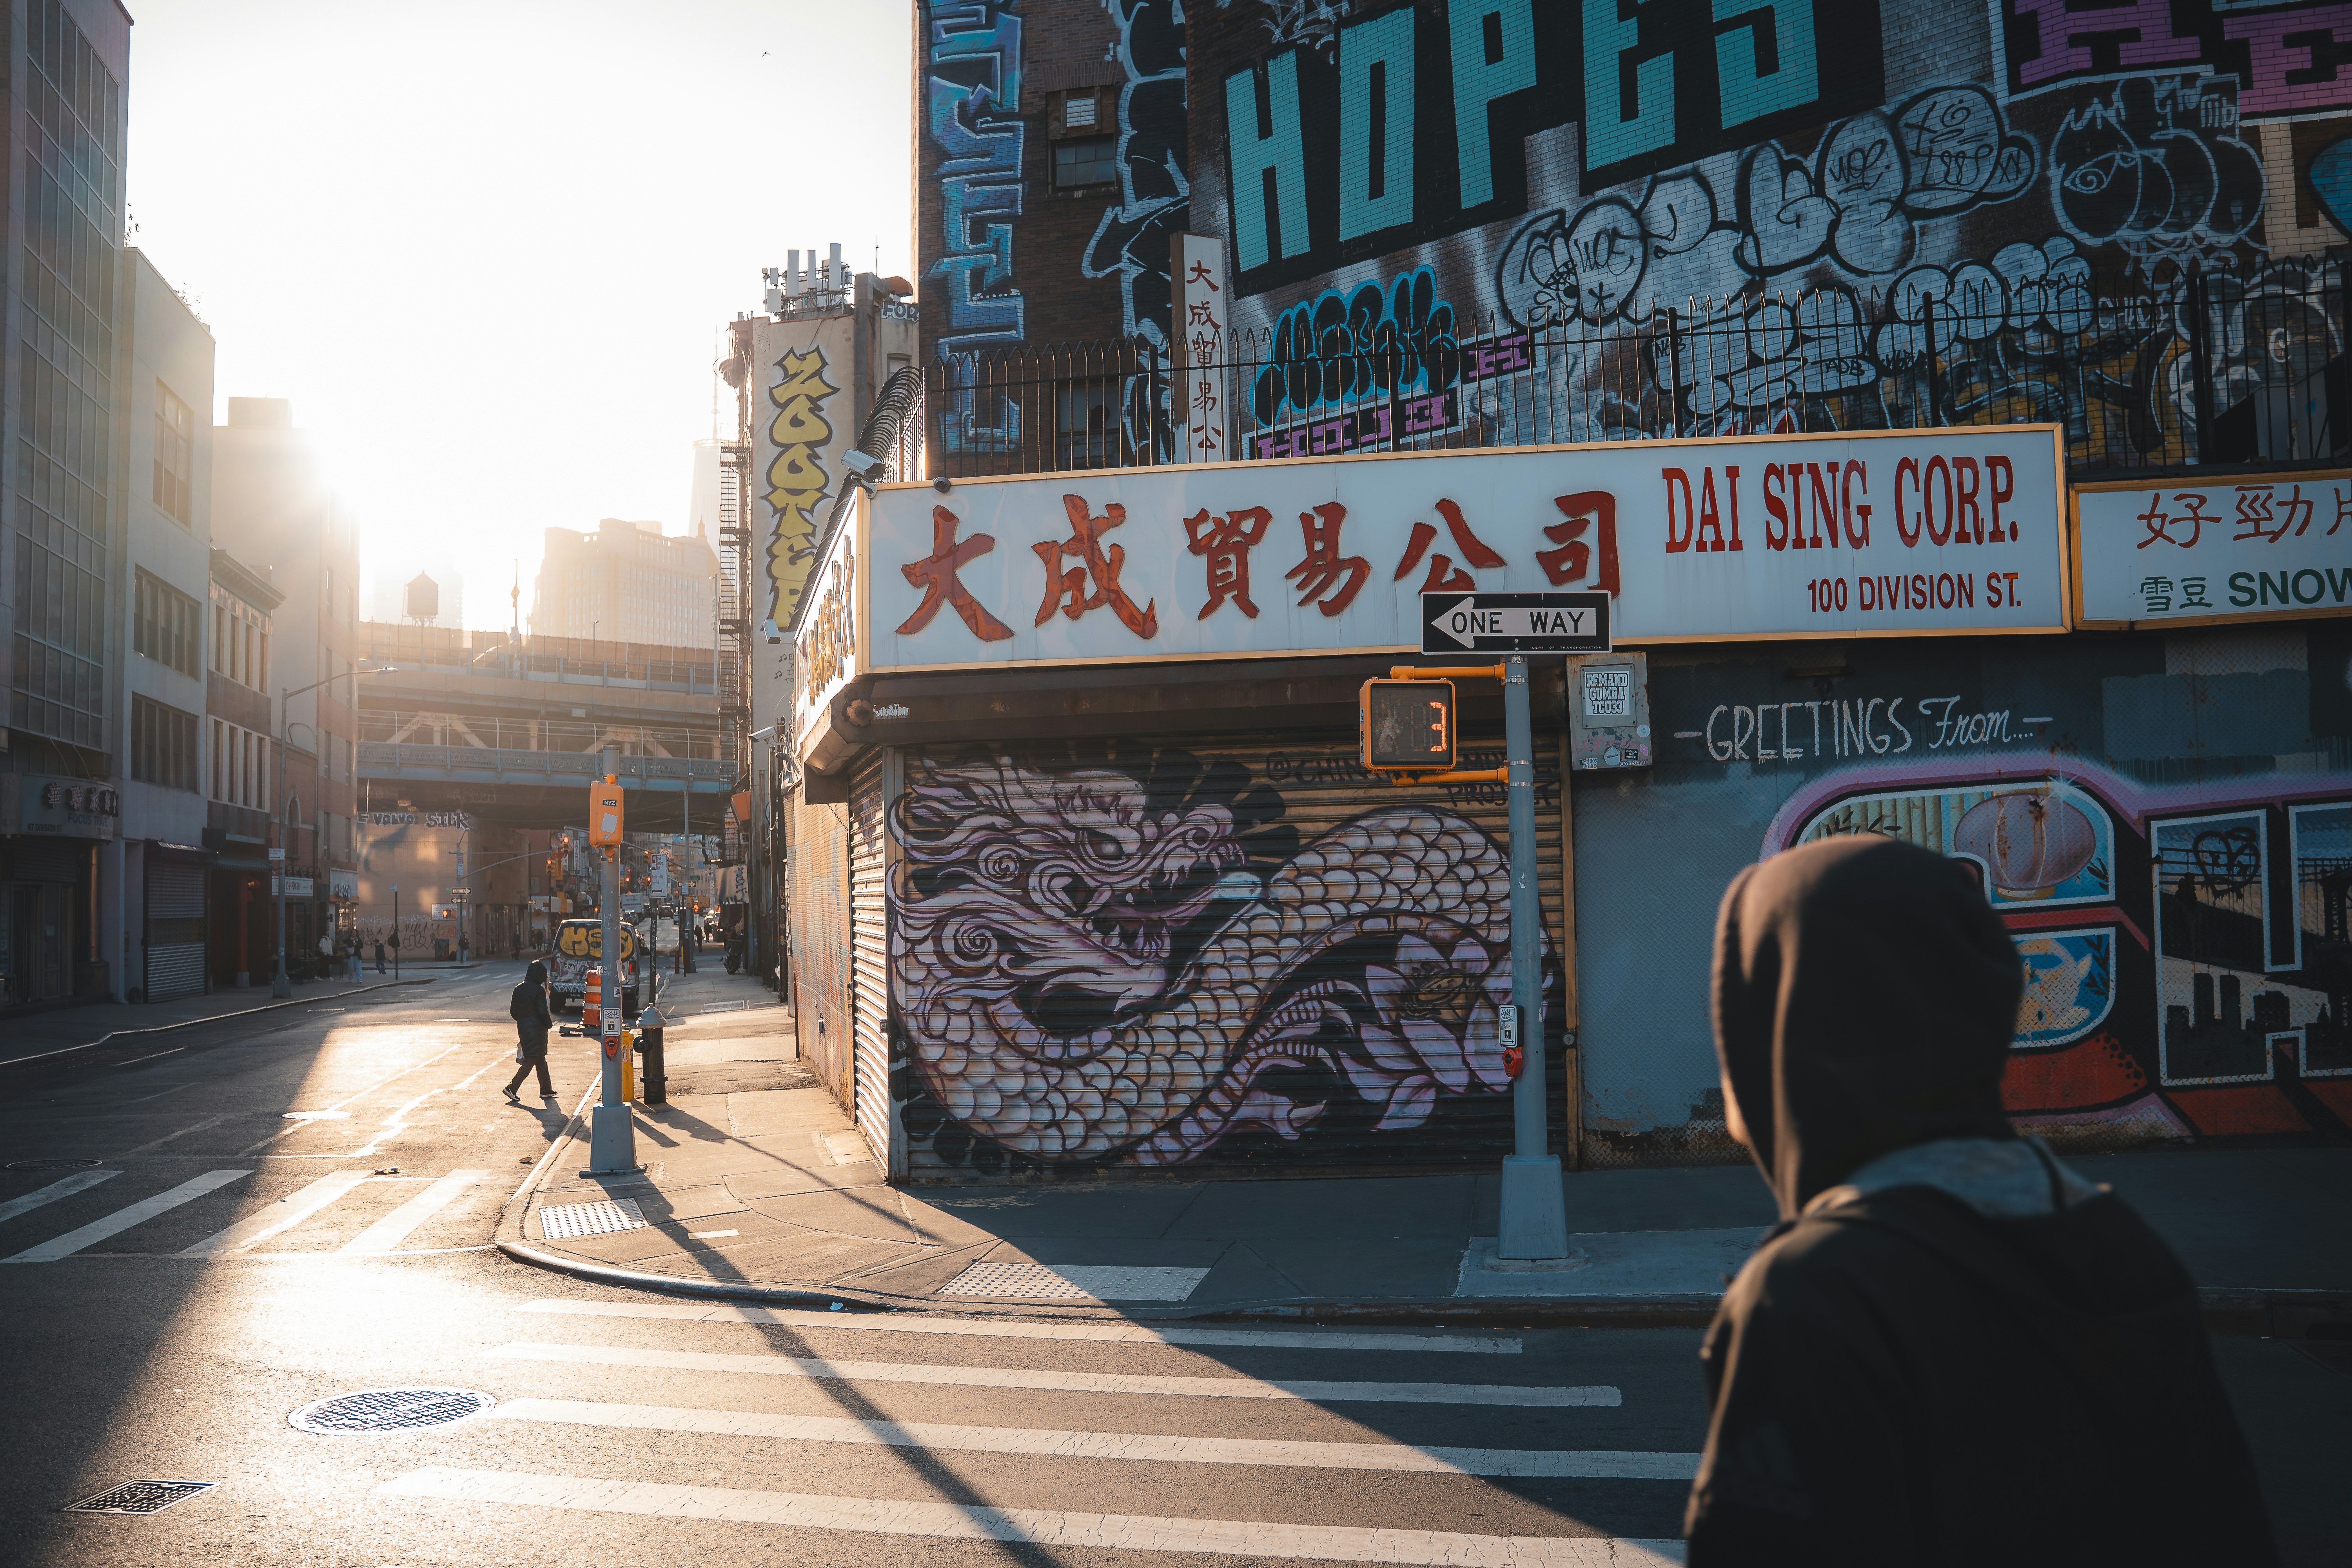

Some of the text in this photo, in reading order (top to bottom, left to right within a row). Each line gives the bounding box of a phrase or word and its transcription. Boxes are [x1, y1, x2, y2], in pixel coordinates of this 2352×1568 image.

[1662, 455, 2018, 554] DAI SING CORP.
[894, 493, 1621, 642] 大成貿易公司
[1808, 571, 2022, 613] 100 DIVISION ST.
[2140, 576, 2213, 612] 雪豆
[1452, 611, 1585, 634] ONE WAY
[1586, 673, 1628, 688] REMAND
[1589, 687, 1626, 701] GUMBA
[1592, 700, 1624, 714] TCU33
[1707, 697, 1911, 763] GREETINGS
[36, 824, 56, 832] DIVISION
[68, 813, 91, 825] FOCUS
[94, 815, 108, 827] TRAVEL
